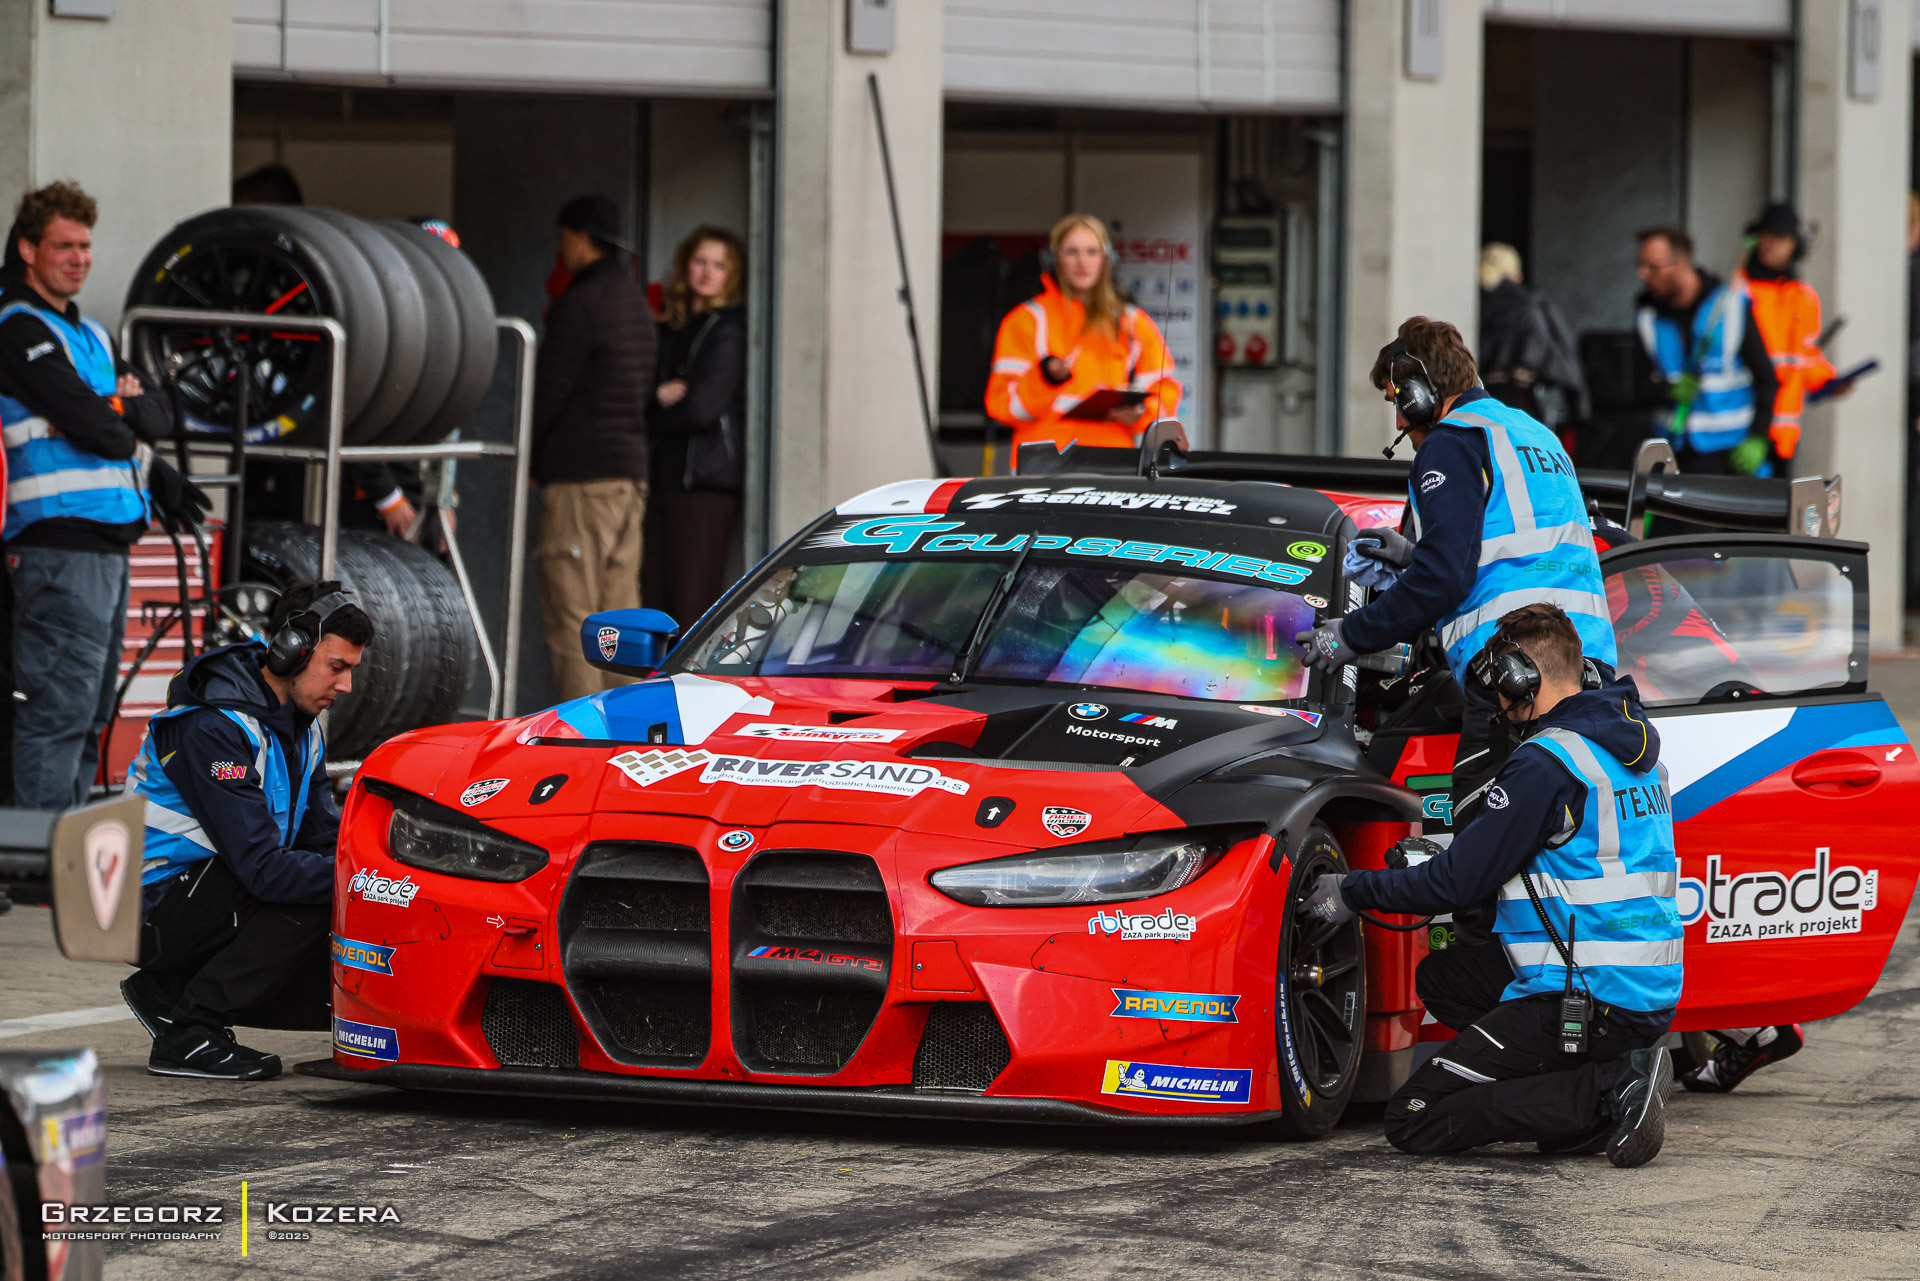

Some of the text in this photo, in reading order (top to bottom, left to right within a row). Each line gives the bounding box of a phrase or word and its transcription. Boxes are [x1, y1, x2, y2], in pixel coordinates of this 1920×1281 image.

[1516, 445, 1577, 480] TEAM
[1019, 493, 1237, 516] senkyr.cz
[842, 513, 966, 553] GT
[1065, 537, 1312, 586] SERIES
[778, 731, 886, 740] senkyr.cz
[1066, 725, 1161, 748] Motorsport
[217, 765, 247, 780] KW
[711, 757, 966, 792] RIVERSAND a.s.
[865, 782, 915, 793] kameniva
[1614, 784, 1670, 820] TEAM
[349, 869, 413, 898] rbtrade
[1676, 852, 1861, 921] btrade
[1864, 873, 1875, 907] s.r.o.
[363, 892, 408, 907] ZAZA park projekt
[1089, 909, 1189, 933] rbtrade
[1607, 915, 1650, 931] ESET
[1710, 916, 1858, 939] ZAZA park projekt
[1144, 931, 1161, 941] park
[1163, 932, 1189, 941] projekt
[332, 941, 386, 967] RAVENOL
[768, 947, 884, 971] M4 GT3
[1125, 996, 1231, 1016] RAVENOL
[338, 1029, 386, 1050] MICHELIN
[1150, 1075, 1238, 1092] MICHELIN
